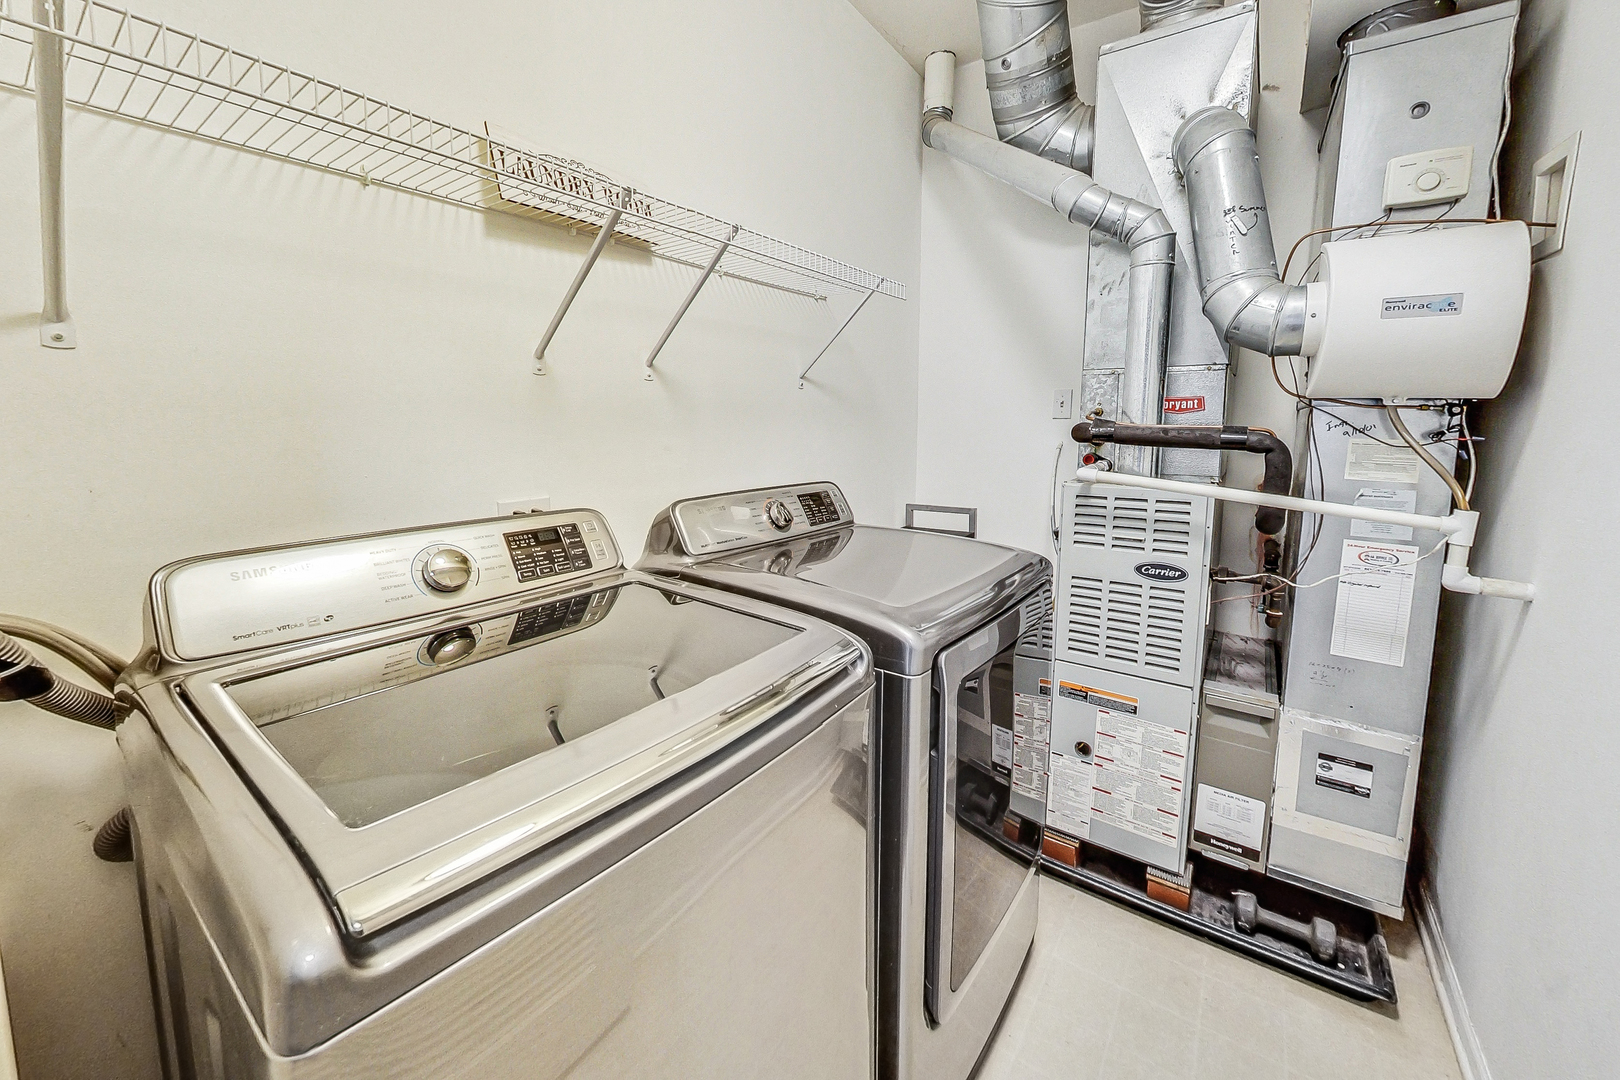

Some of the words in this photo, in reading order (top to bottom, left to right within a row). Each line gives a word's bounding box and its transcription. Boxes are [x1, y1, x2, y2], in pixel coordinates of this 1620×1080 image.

[1141, 566, 1182, 578] Carrier
[232, 628, 274, 641] SmartCare
[276, 622, 305, 632] VRTplus
[1210, 838, 1243, 854] Honeywell
